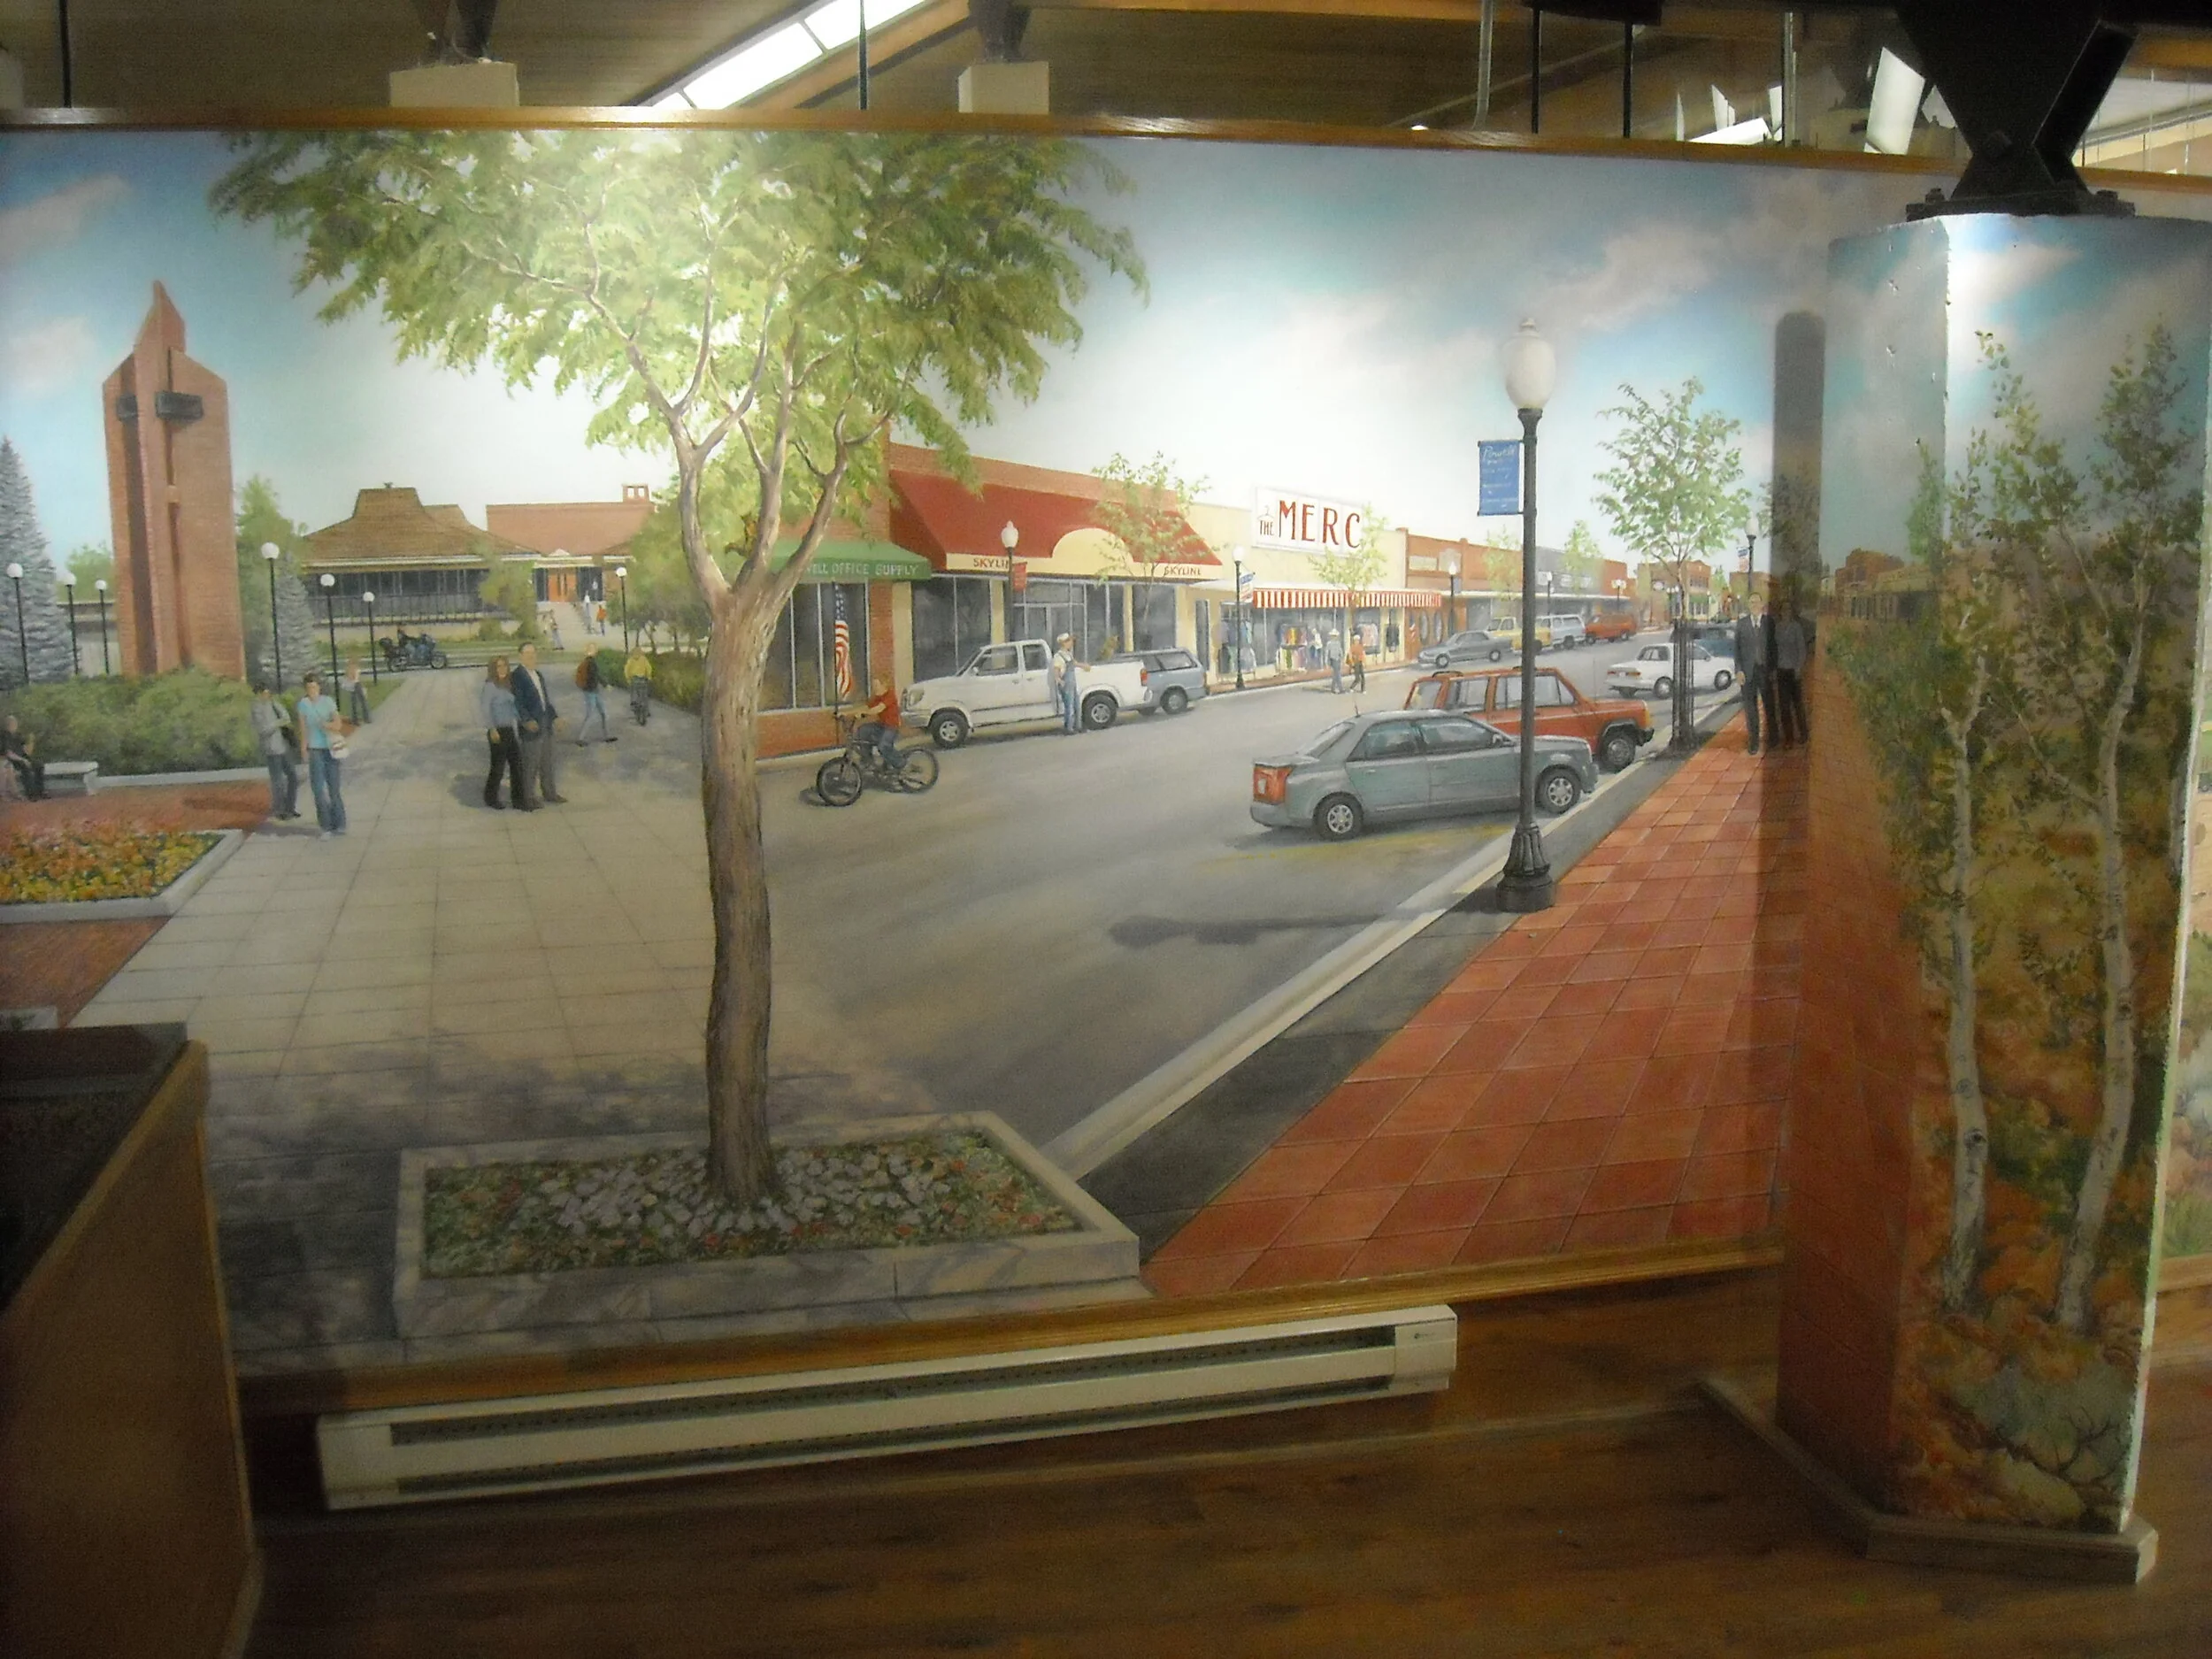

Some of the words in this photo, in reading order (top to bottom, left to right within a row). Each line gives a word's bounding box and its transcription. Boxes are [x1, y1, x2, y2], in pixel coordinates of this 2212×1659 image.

[1259, 519, 1274, 536] THE
[1279, 499, 1361, 549] MERC
[832, 563, 870, 575] OFFICE
[875, 565, 918, 575] SUPPLY
